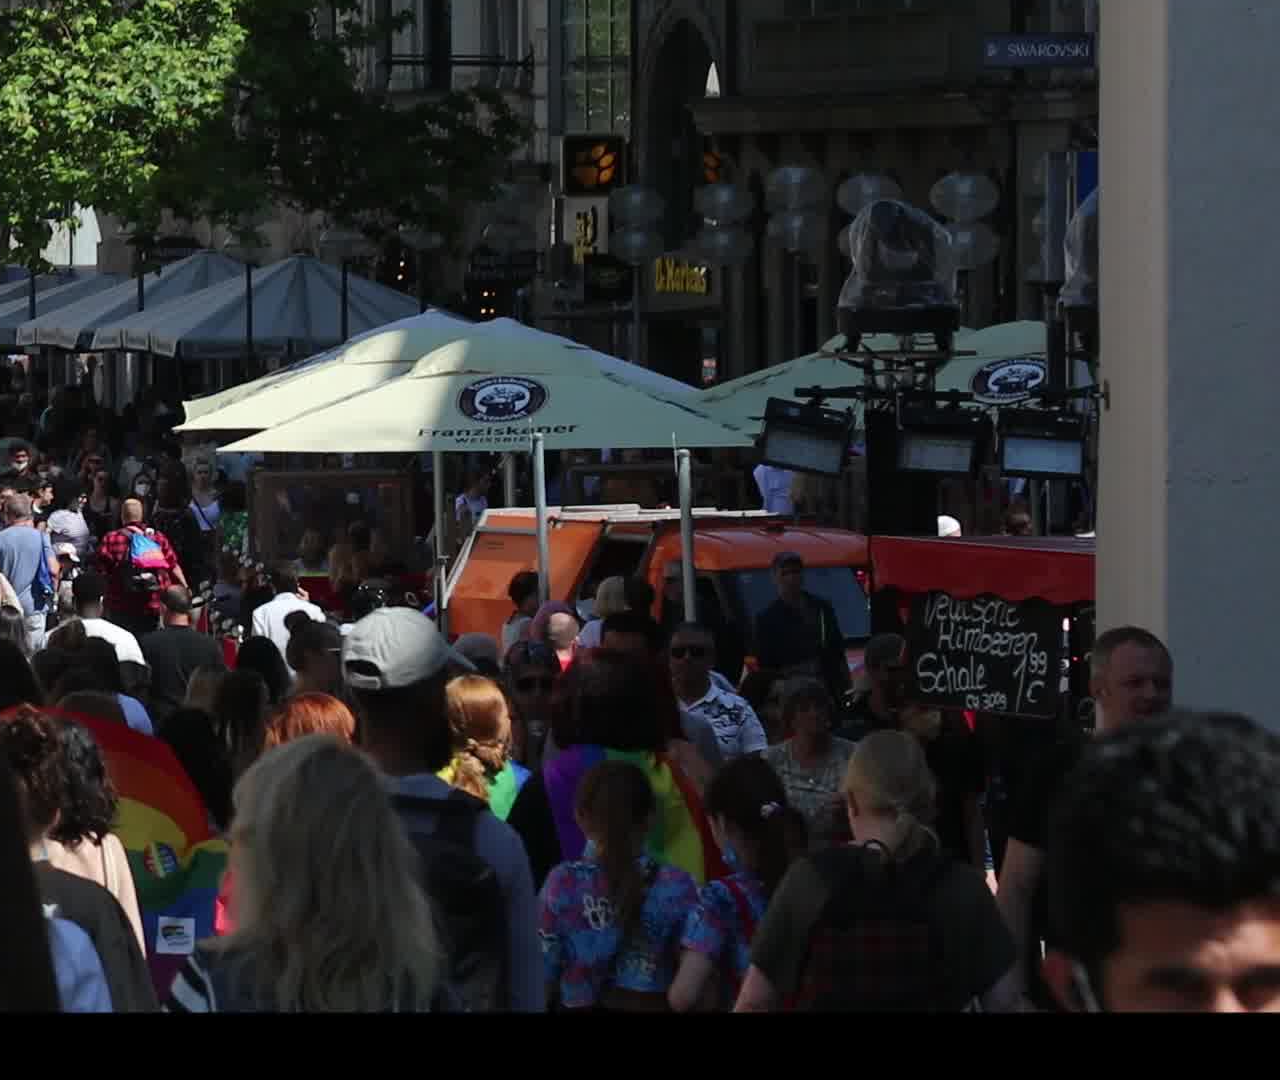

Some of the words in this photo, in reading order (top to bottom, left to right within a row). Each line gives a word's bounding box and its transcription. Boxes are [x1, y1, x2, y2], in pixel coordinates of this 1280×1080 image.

[1007, 40, 1090, 57] SWAROVSKI
[417, 424, 577, 438] Franziskaner
[454, 435, 532, 445] WEISSBIE
[937, 620, 1039, 658] Himbeeren
[916, 650, 989, 695] Schale
